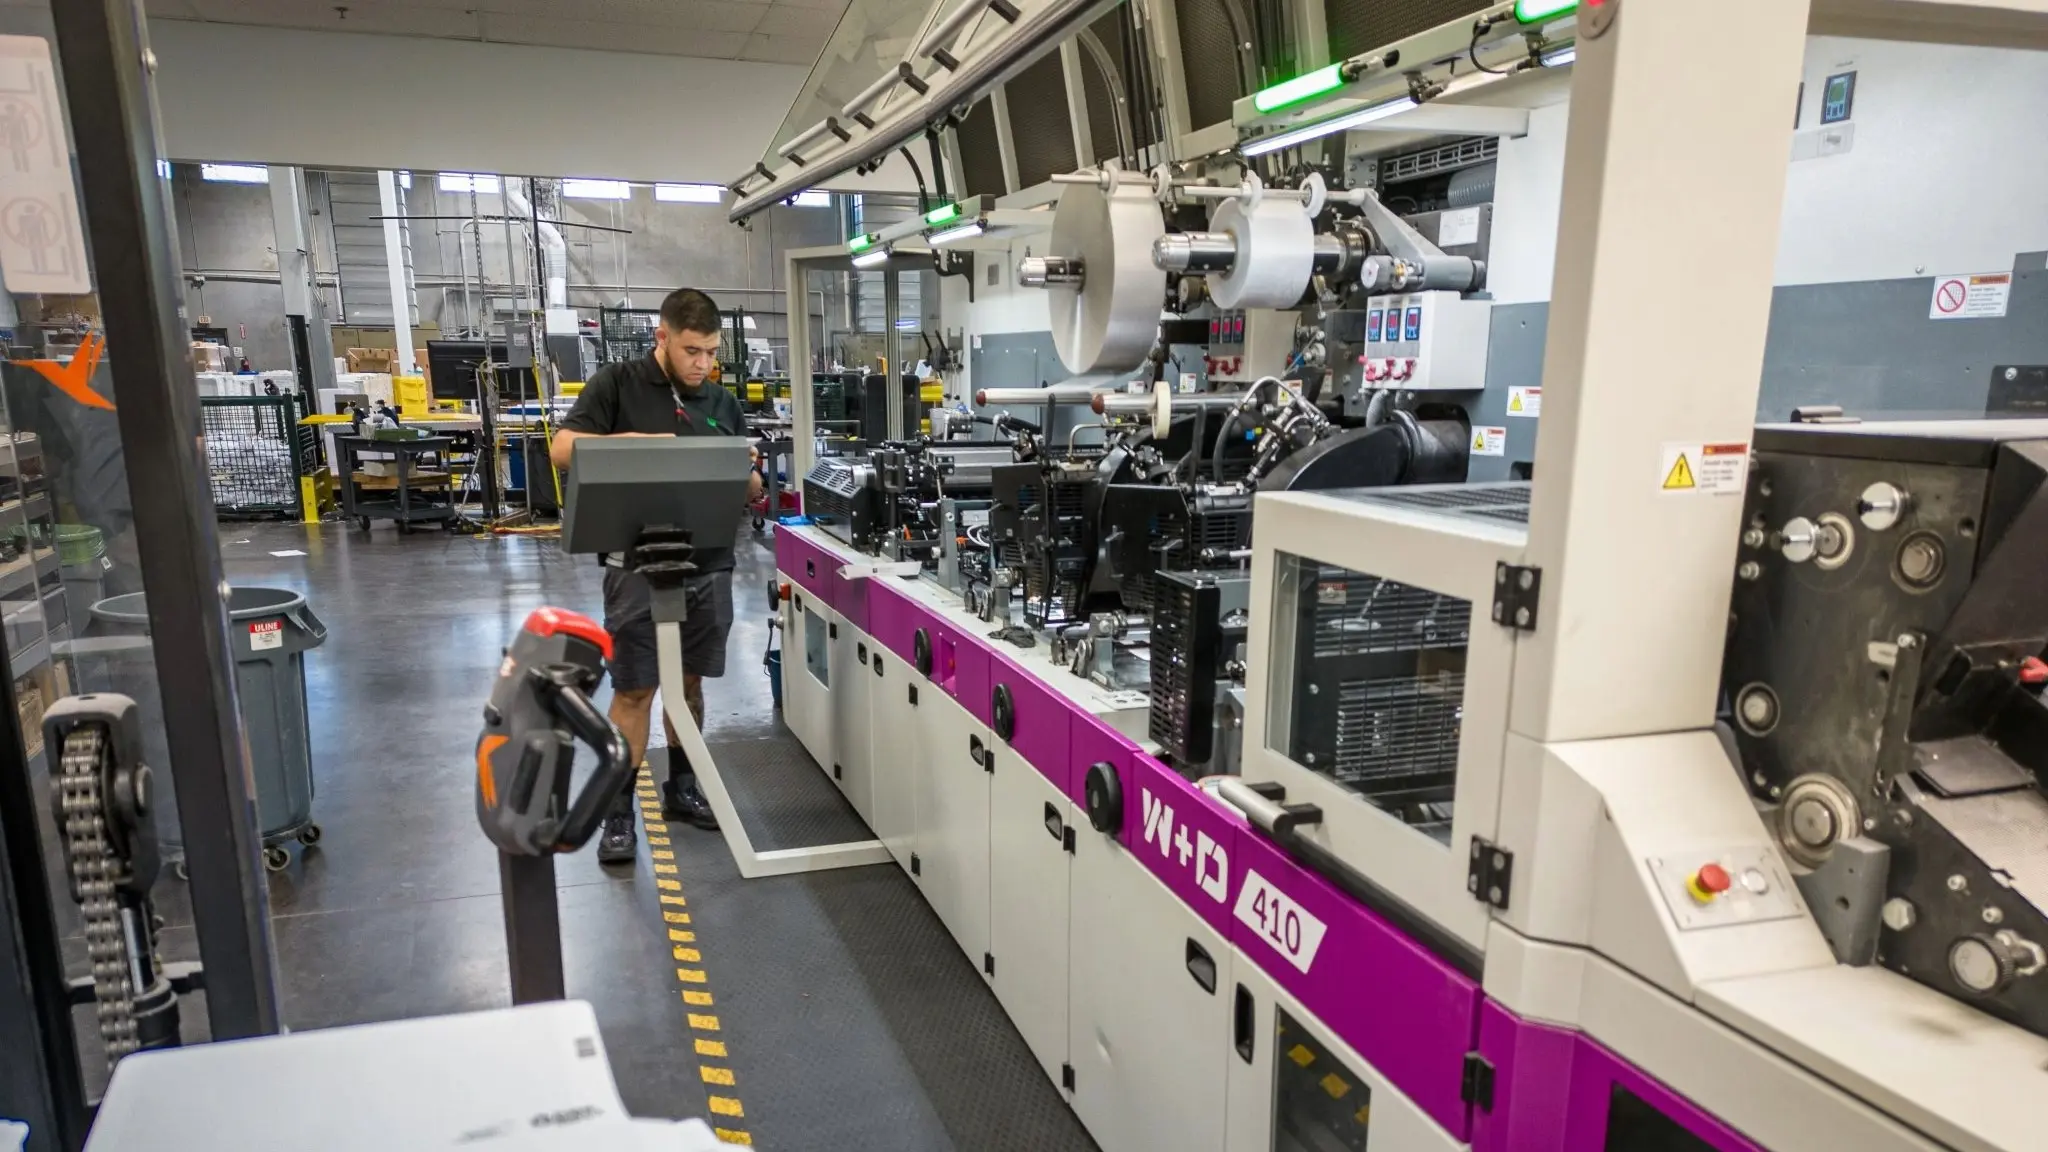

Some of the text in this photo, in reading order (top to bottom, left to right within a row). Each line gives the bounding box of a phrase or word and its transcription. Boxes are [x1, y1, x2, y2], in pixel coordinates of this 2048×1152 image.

[254, 621, 278, 631] ULINE
[1142, 787, 1301, 956] W+D 410
